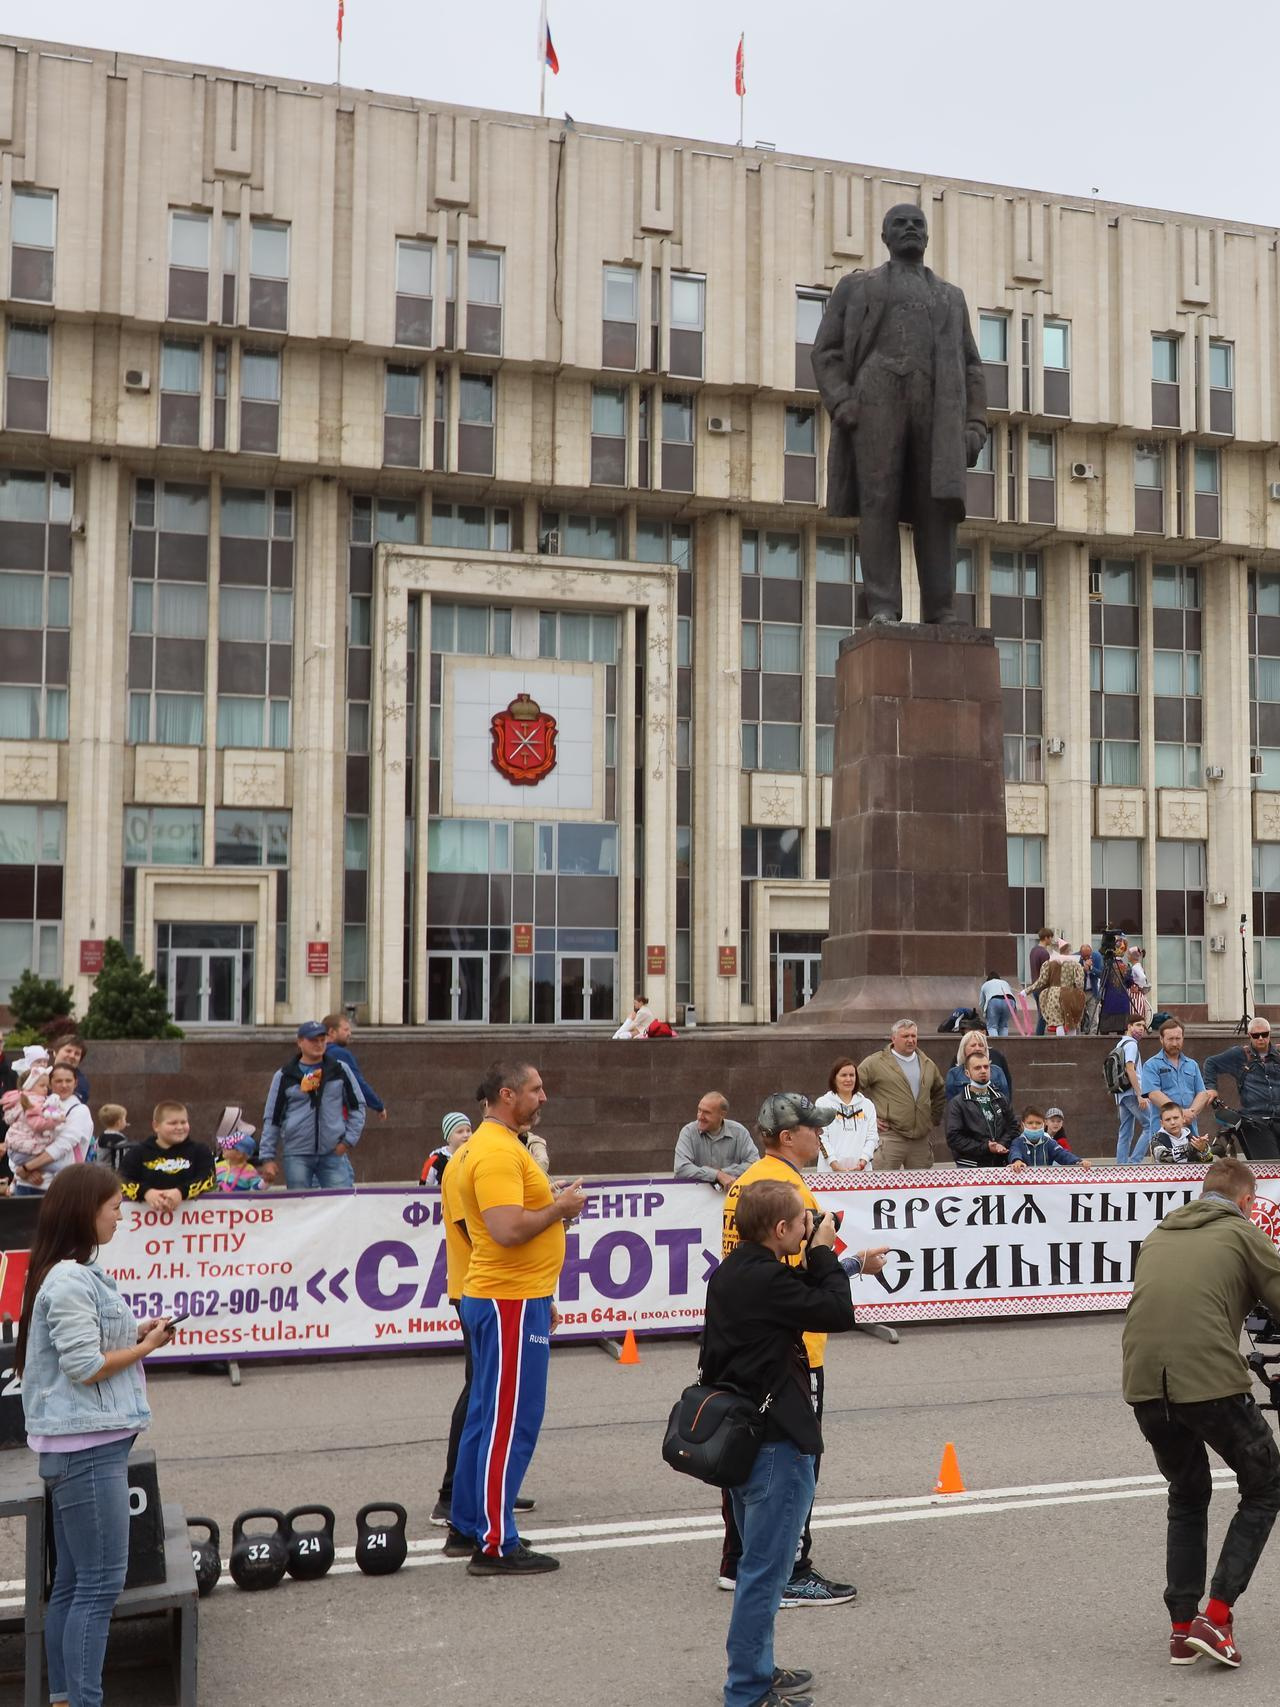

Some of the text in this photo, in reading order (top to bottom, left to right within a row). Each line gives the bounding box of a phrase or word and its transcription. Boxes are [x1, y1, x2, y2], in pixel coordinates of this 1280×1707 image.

[573, 1192, 665, 1225] ЕНТР
[129, 1208, 274, 1232] 300 метров
[145, 1232, 246, 1256] от ТГПУ
[147, 1262, 191, 1281] Л.Н.
[197, 1261, 293, 1278] Толстого
[375, 1321, 402, 1336] ул.
[529, 1334, 549, 1345] RUSSI
[298, 1537, 320, 1555] 24
[366, 1532, 387, 1549] 24
[247, 1543, 271, 1560] 32
